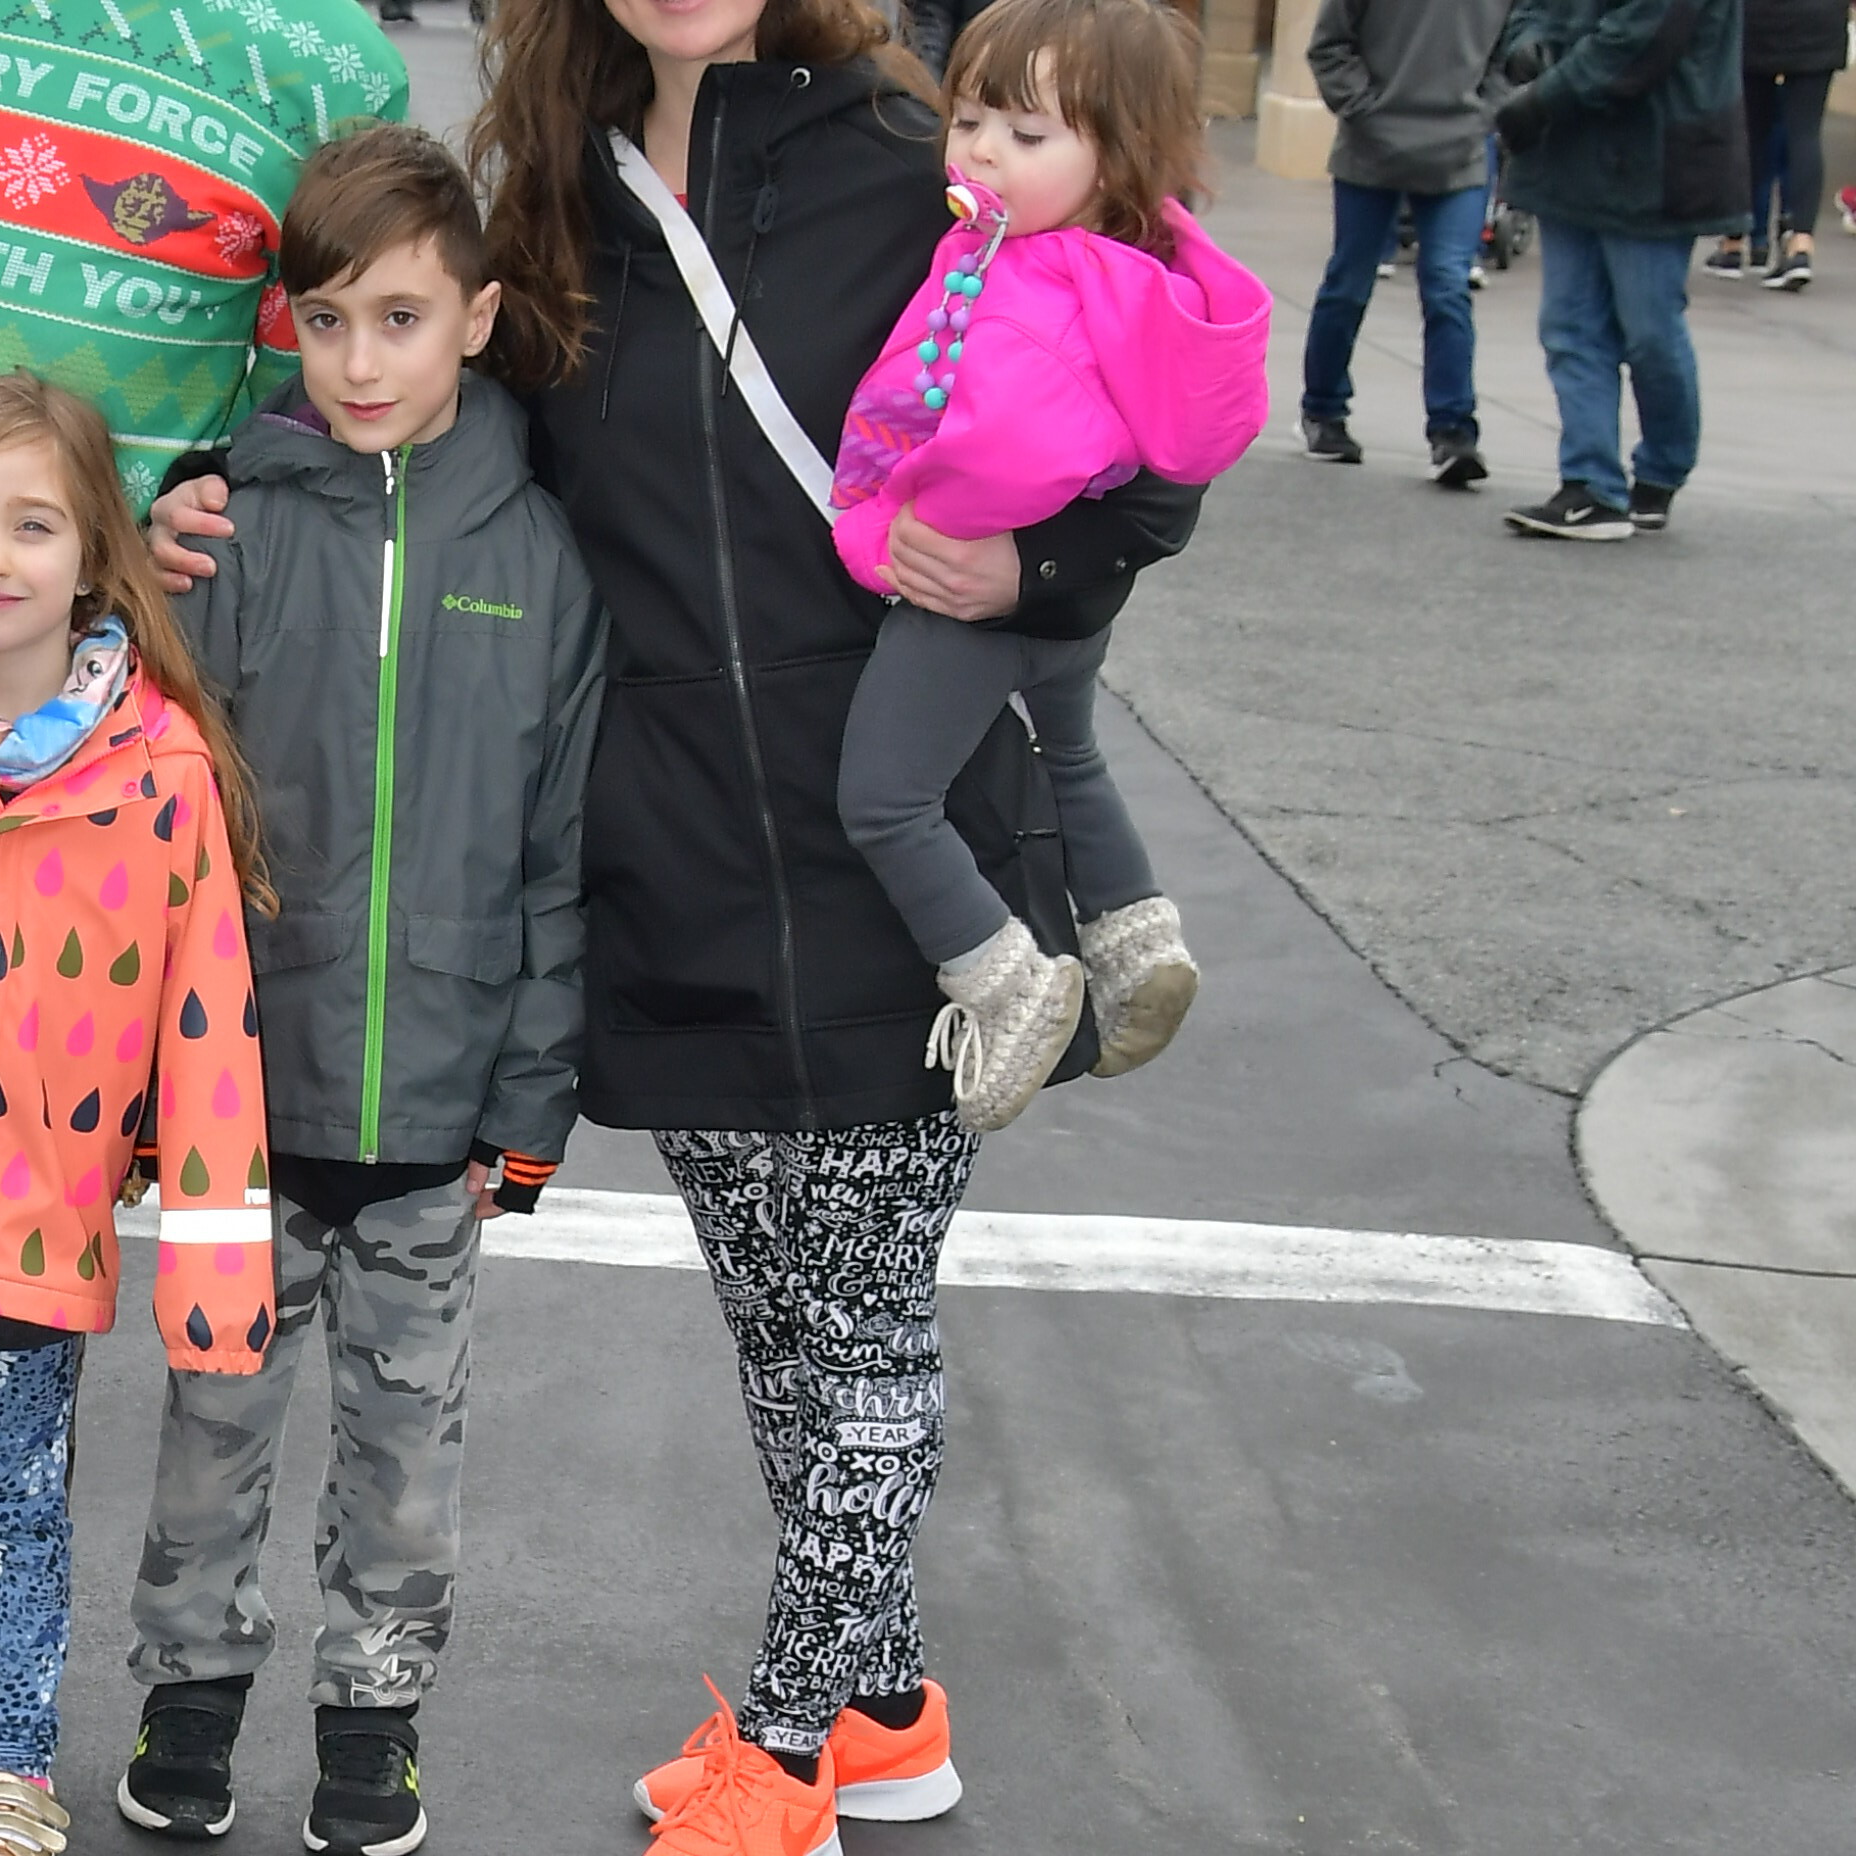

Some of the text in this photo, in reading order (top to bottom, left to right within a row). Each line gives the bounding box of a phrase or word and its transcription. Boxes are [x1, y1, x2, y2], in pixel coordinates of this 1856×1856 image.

[67, 71, 265, 178] FORCE
[80, 261, 201, 326] YOU
[456, 595, 524, 621] Columbia
[827, 1128, 906, 1148] WISHES
[818, 1145, 949, 1187] HAPPY
[810, 1182, 871, 1208] new
[870, 1180, 924, 1200] HOLLY
[821, 1233, 929, 1271] MERRY
[850, 1425, 910, 1443] YEAR
[806, 1462, 931, 1537] holly
[783, 1515, 894, 1594] HAPPY
[811, 1575, 870, 1603] HOLLY
